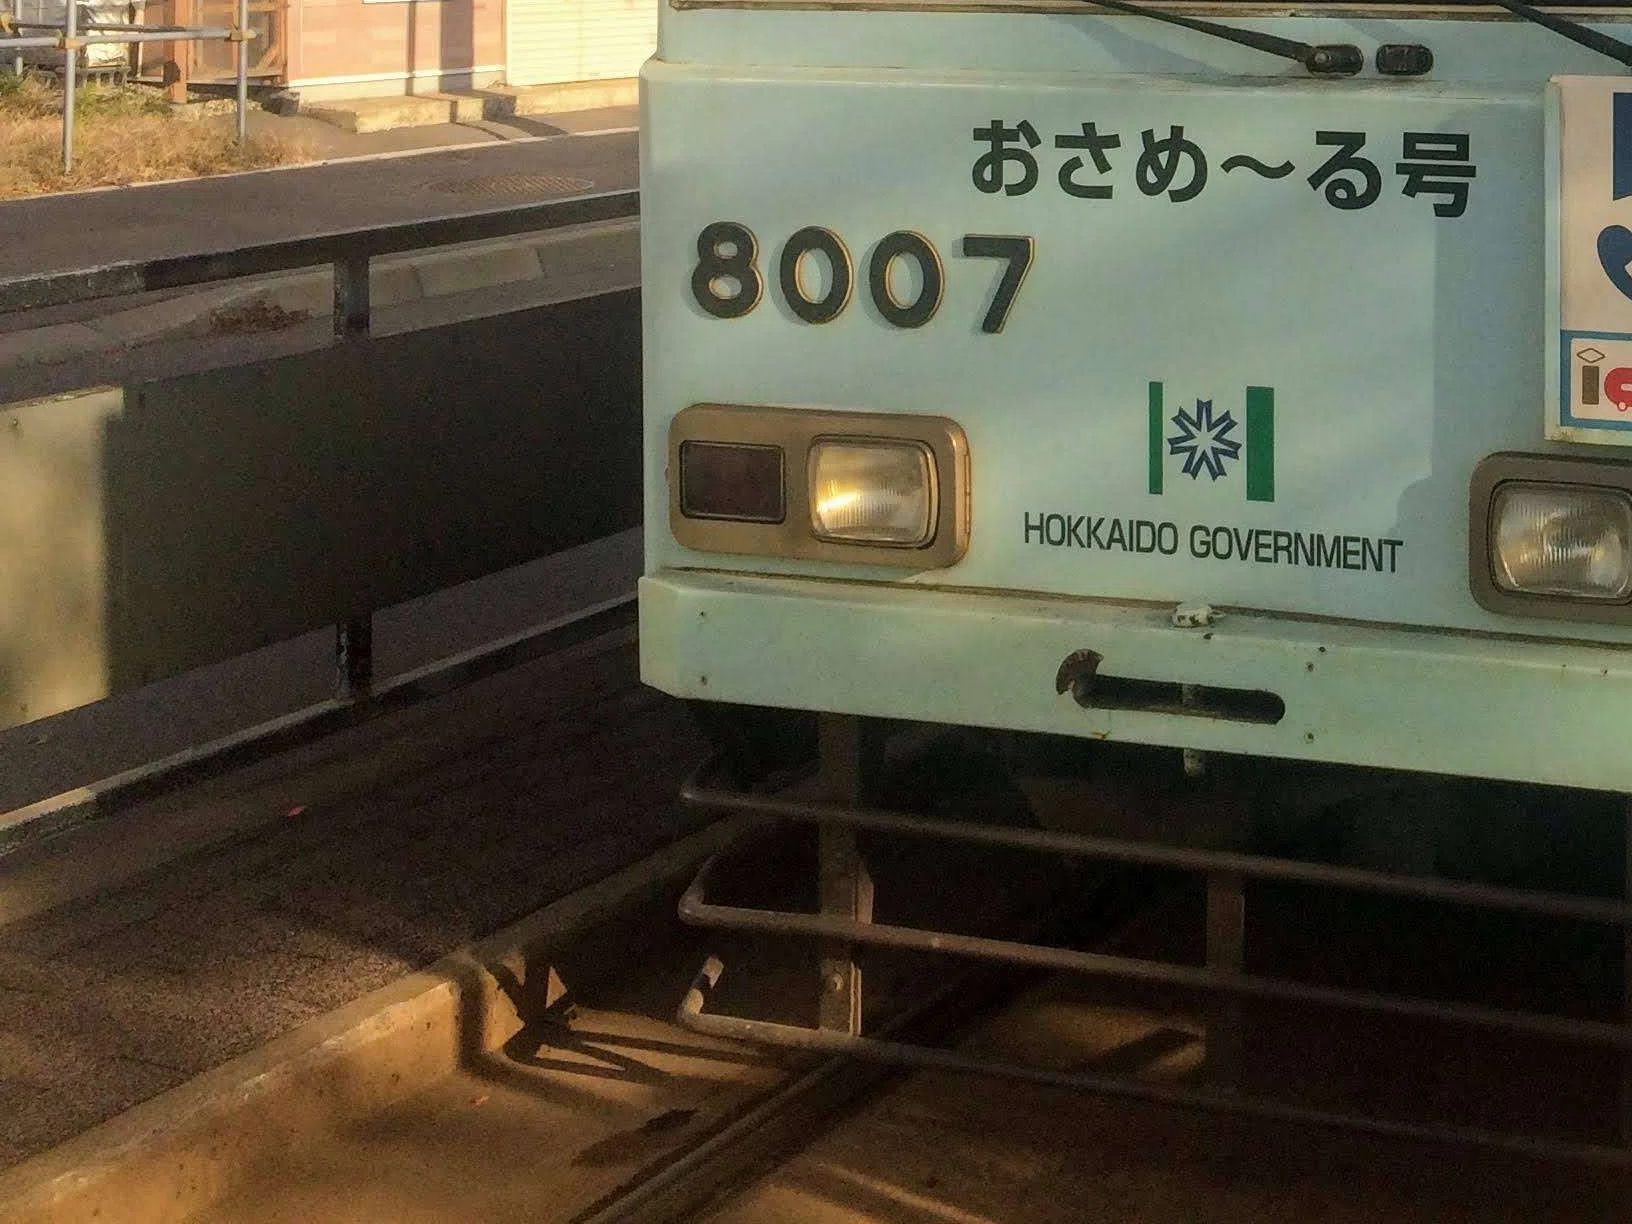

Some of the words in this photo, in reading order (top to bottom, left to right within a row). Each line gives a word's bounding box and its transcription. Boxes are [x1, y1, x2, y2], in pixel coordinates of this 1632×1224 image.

[691, 221, 1036, 334] 8007
[1024, 511, 1178, 555] HOKKAIDO
[1190, 525, 1404, 573] GOVERNMENT
